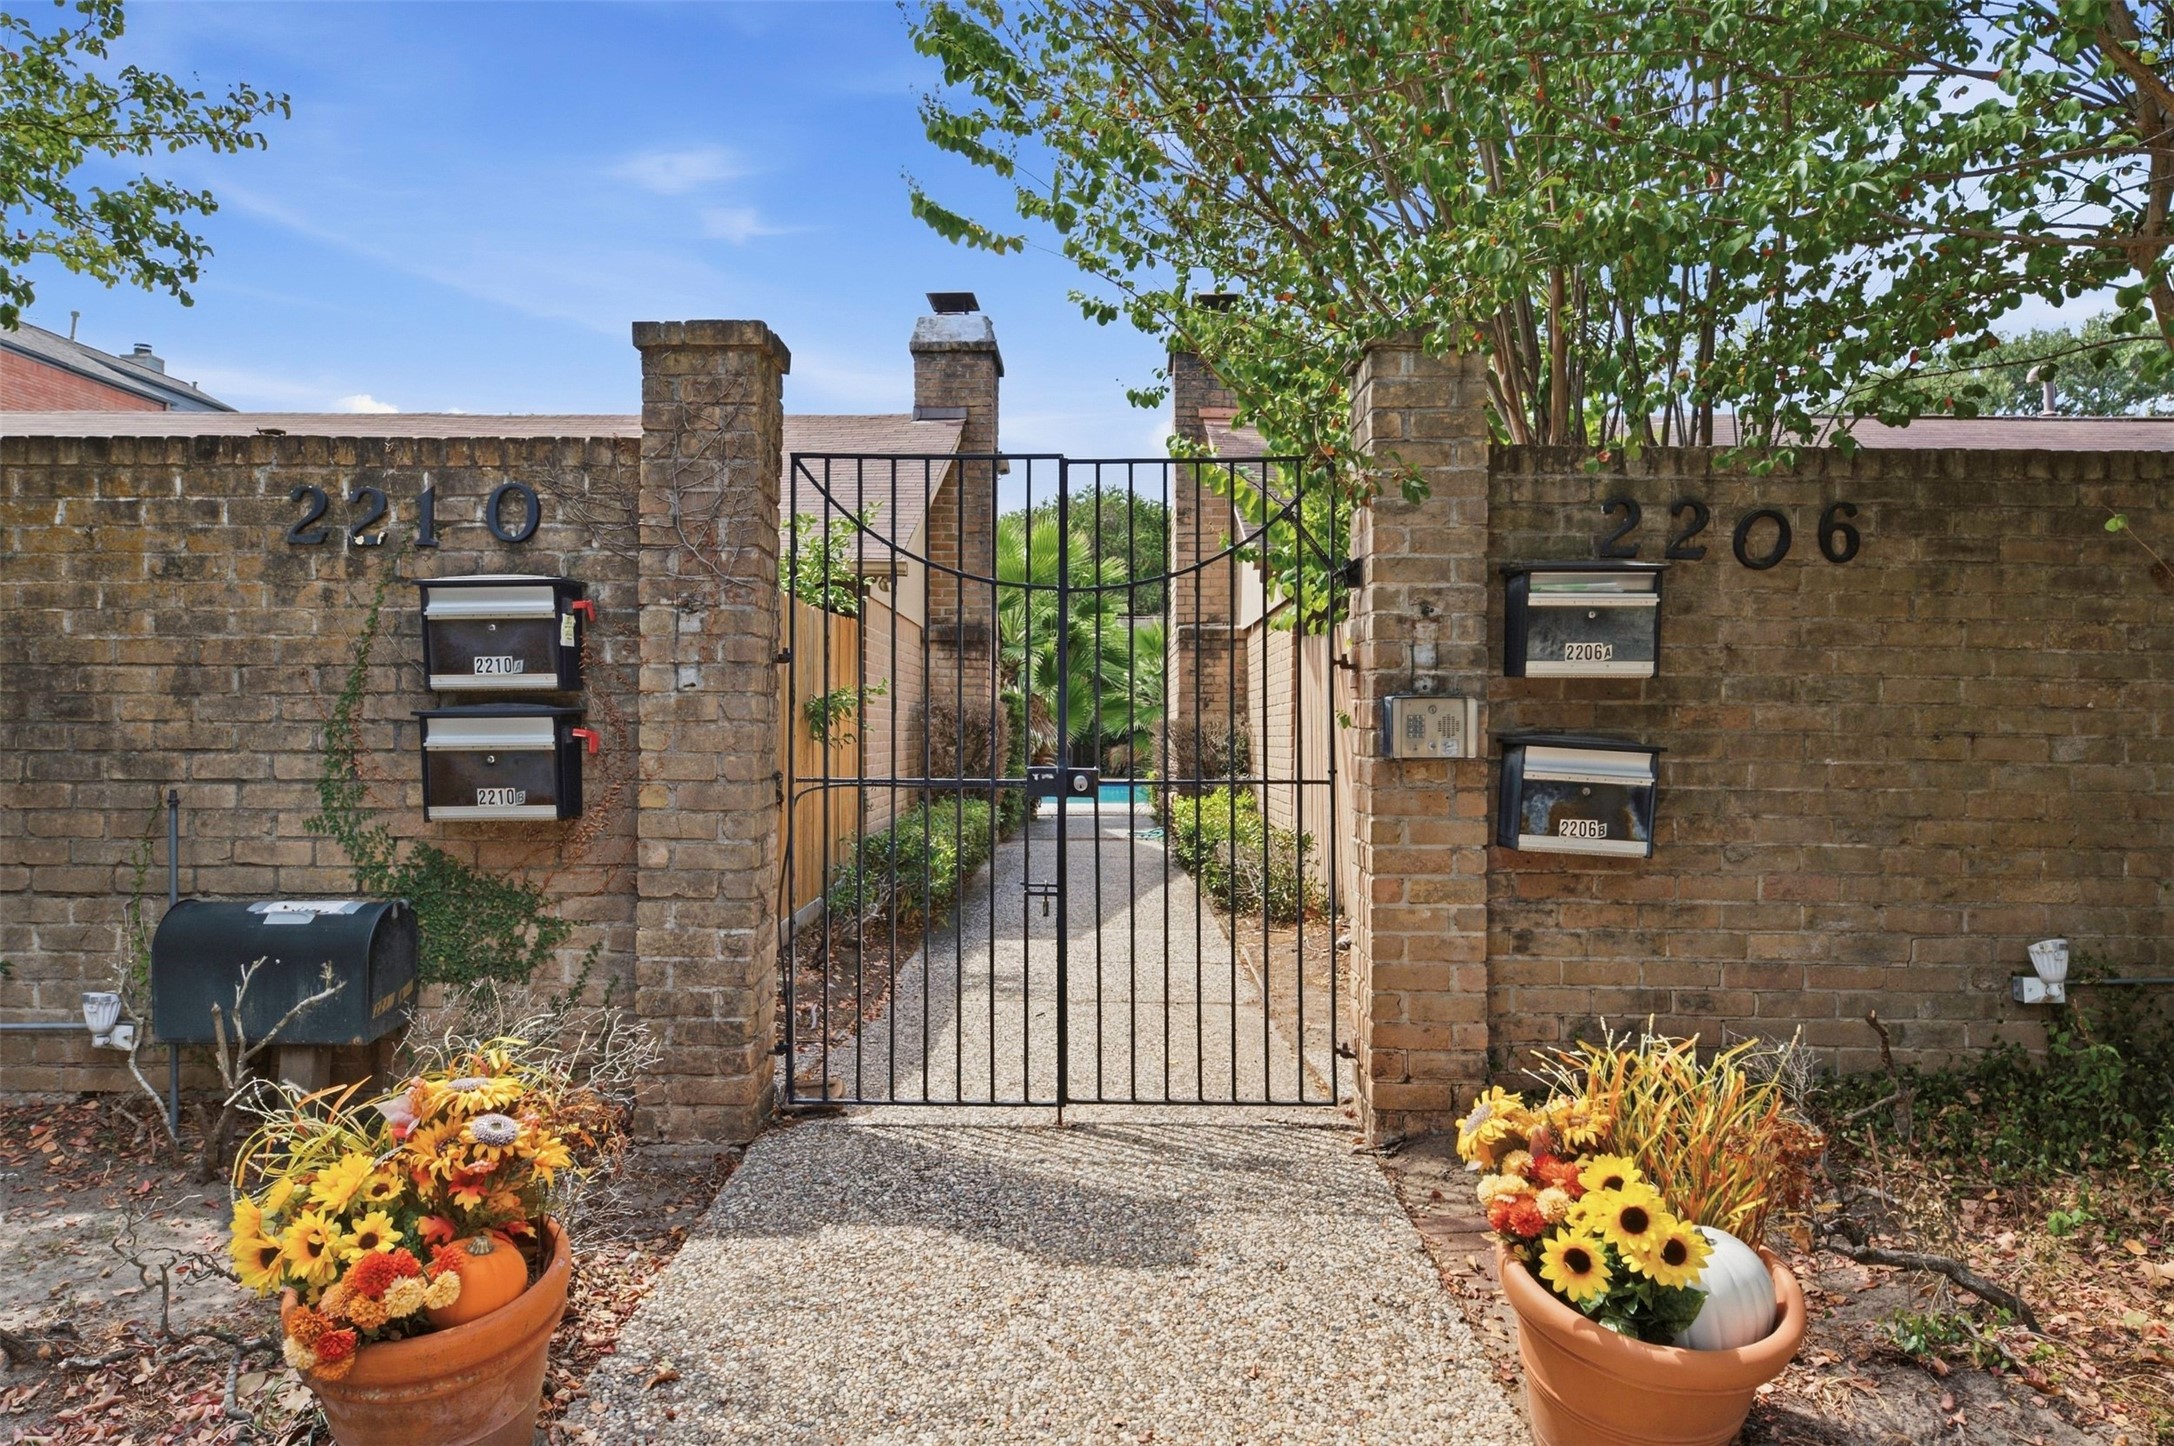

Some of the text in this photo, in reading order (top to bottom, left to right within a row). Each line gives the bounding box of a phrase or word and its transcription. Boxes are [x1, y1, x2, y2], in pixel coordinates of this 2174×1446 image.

[288, 482, 542, 547] 2210
[1600, 496, 1861, 570] 2206
[1566, 644, 1611, 660] 2206A
[478, 789, 524, 805] 2210B
[1560, 820, 1605, 837] 2206B
